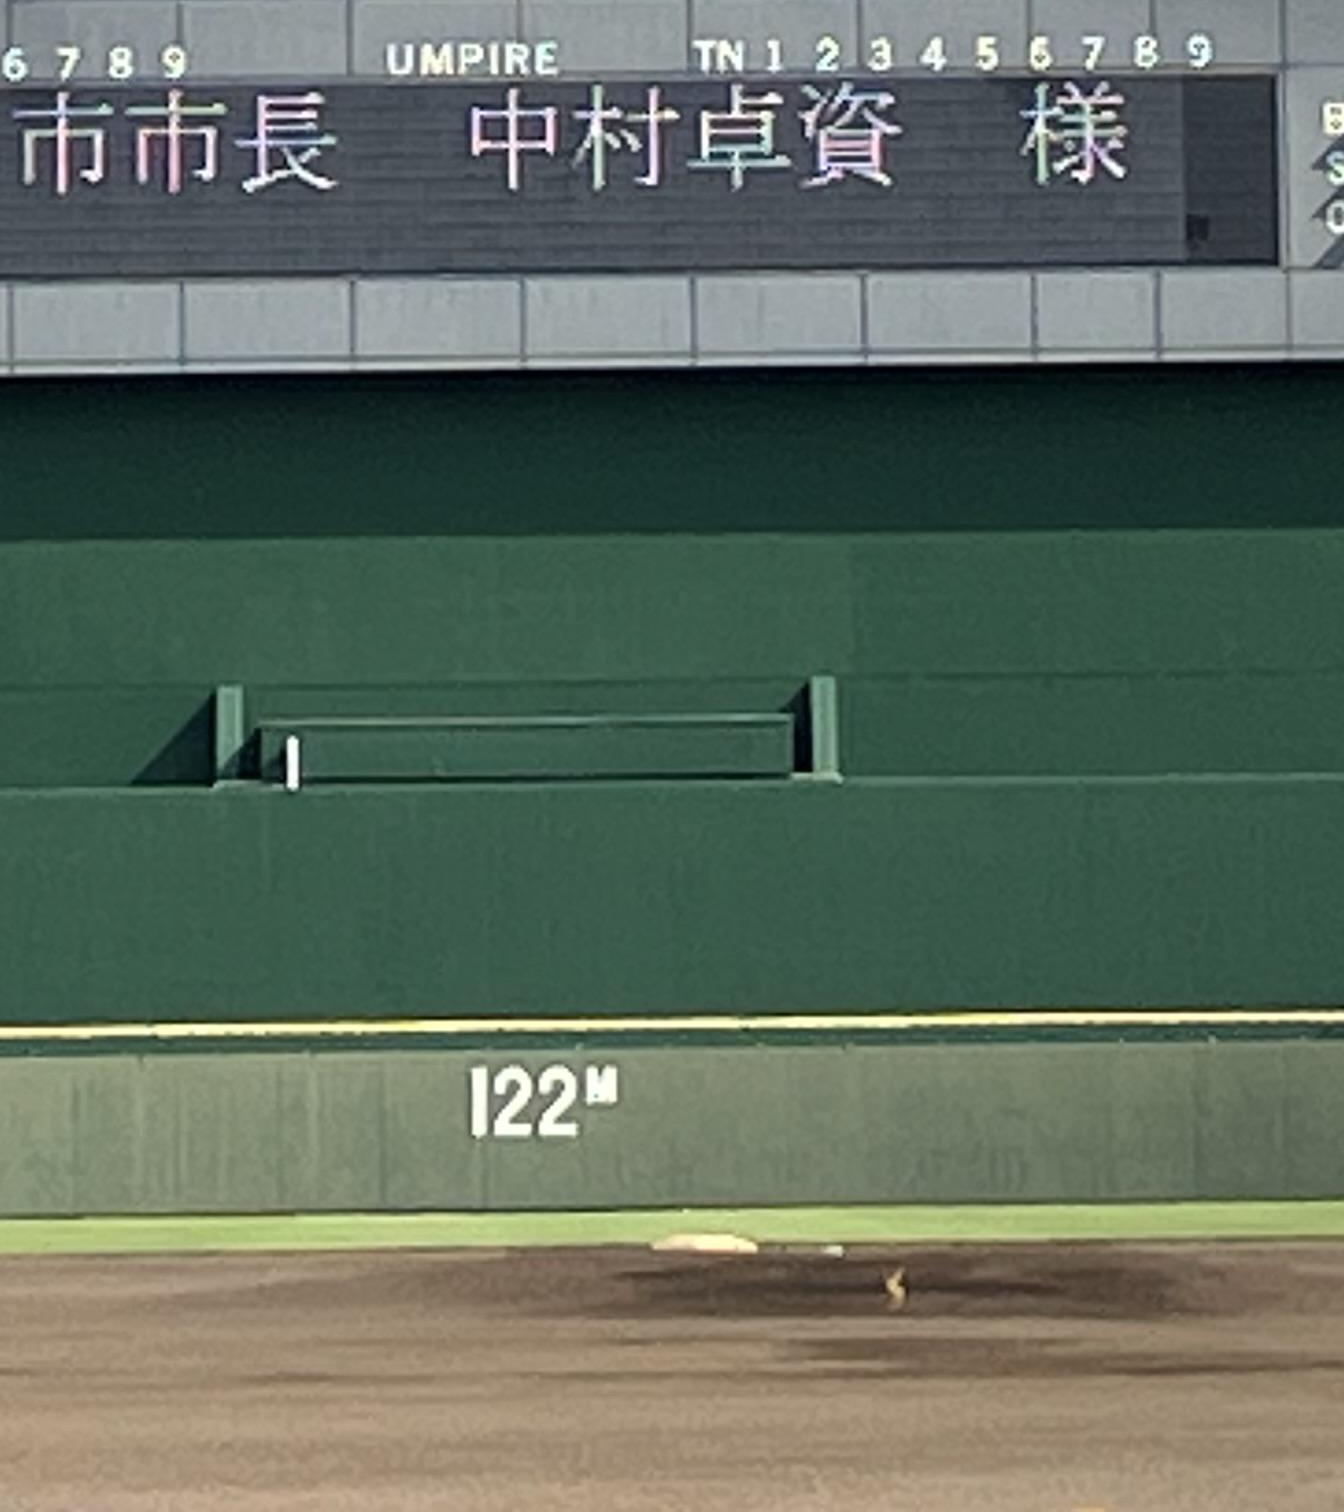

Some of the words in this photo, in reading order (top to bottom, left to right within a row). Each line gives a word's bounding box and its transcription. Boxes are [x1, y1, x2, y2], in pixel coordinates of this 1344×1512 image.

[2, 48, 28, 82] 6
[56, 47, 80, 80] 7
[109, 47, 134, 80] 8
[162, 46, 186, 79] 9
[386, 41, 560, 76] UMPIRE
[693, 39, 744, 72] TN
[766, 39, 783, 73] 1
[815, 37, 840, 72] 2
[867, 37, 893, 71] 3
[920, 37, 947, 71] 4
[976, 36, 1000, 71] 5
[1029, 36, 1053, 70] 6
[1081, 36, 1106, 69] 7
[1134, 36, 1159, 68] 8
[1187, 35, 1212, 68] 9
[468, 83, 903, 191] 中村卓資
[1018, 80, 1130, 186] 様
